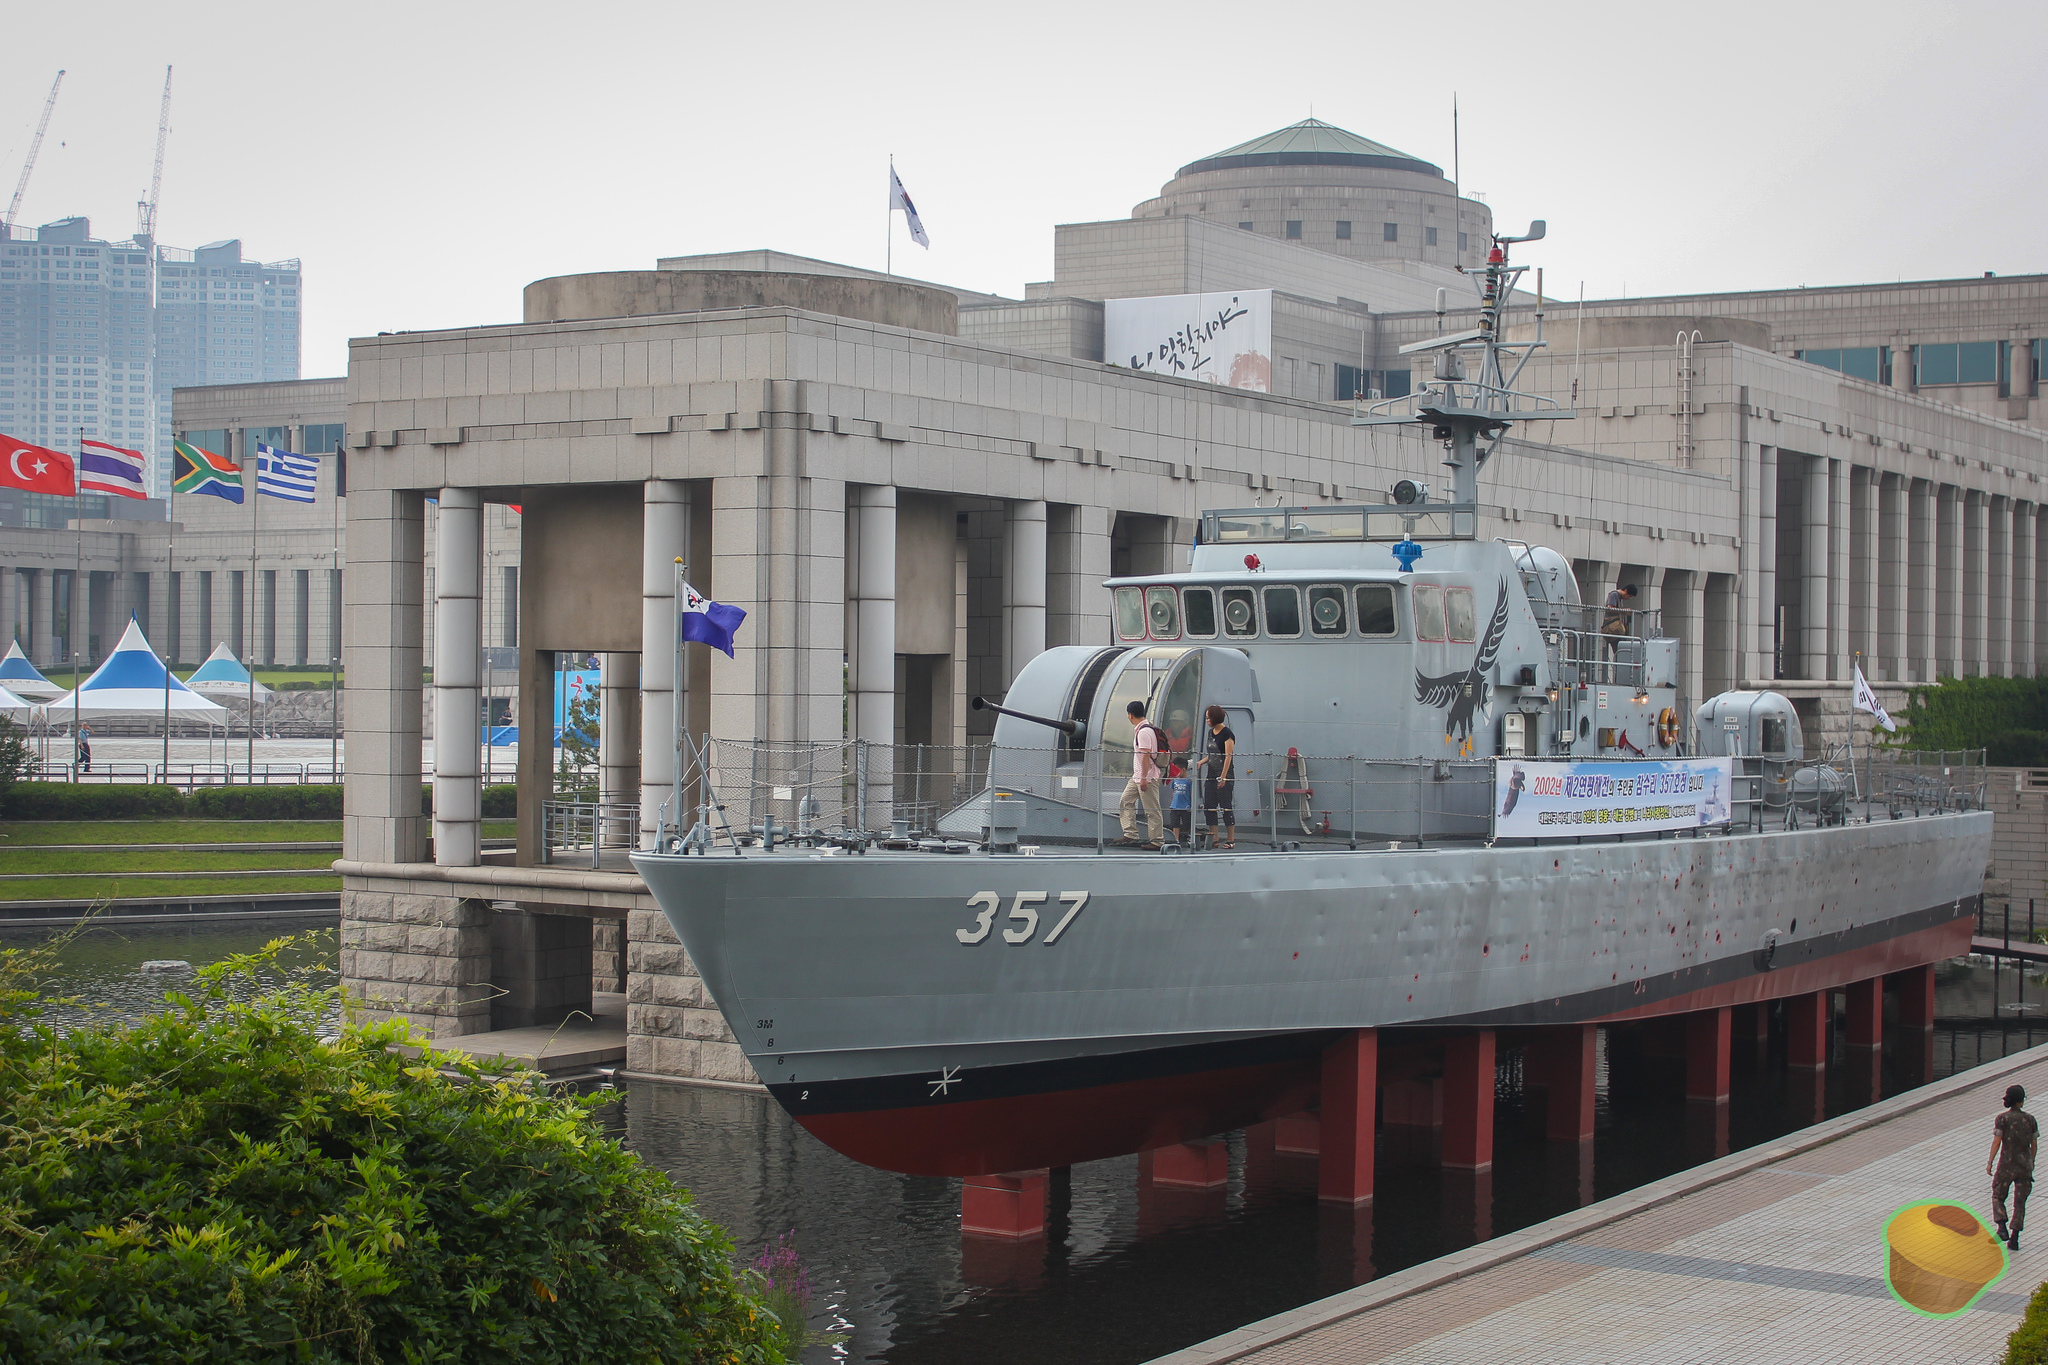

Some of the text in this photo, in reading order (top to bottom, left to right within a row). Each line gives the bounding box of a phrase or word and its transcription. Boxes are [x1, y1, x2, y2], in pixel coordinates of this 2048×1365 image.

[1534, 776, 1562, 796] 2002년
[1564, 775, 1615, 798] 제2연평해전의
[1617, 779, 1634, 796] 주인공
[1636, 773, 1658, 796] 참수리
[1660, 772, 1687, 794] 357호정
[1583, 808, 1597, 824] 6인의
[955, 890, 1092, 947] 357
[757, 1019, 773, 1029] 3M
[767, 1038, 774, 1047] 8
[777, 1056, 784, 1065] 6
[789, 1073, 796, 1083] 4
[801, 1090, 809, 1100] 2
